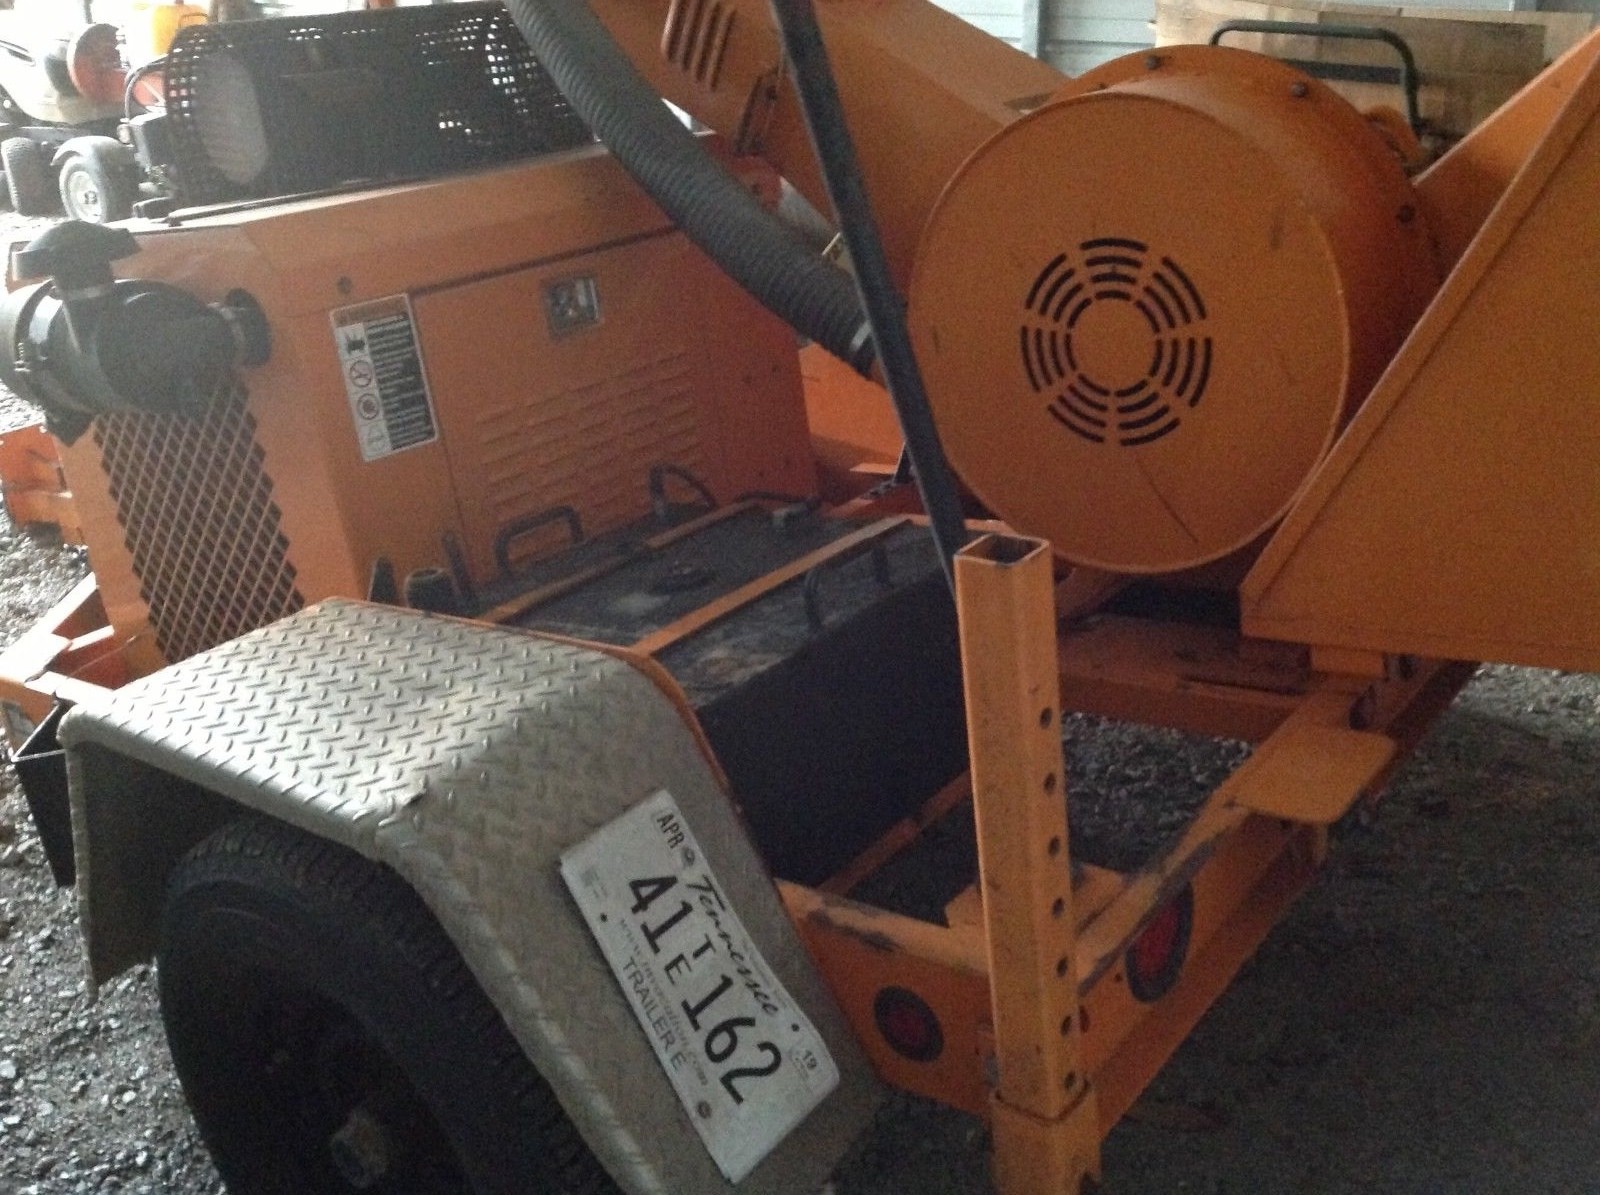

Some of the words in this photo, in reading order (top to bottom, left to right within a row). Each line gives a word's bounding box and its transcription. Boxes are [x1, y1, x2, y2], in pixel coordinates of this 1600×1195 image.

[656, 812, 686, 849] APR
[628, 874, 694, 954] 41
[681, 973, 782, 1106] 162
[685, 873, 779, 1016] Tennessee
[622, 956, 677, 1053] TRAILER
[670, 1051, 688, 1072] E
